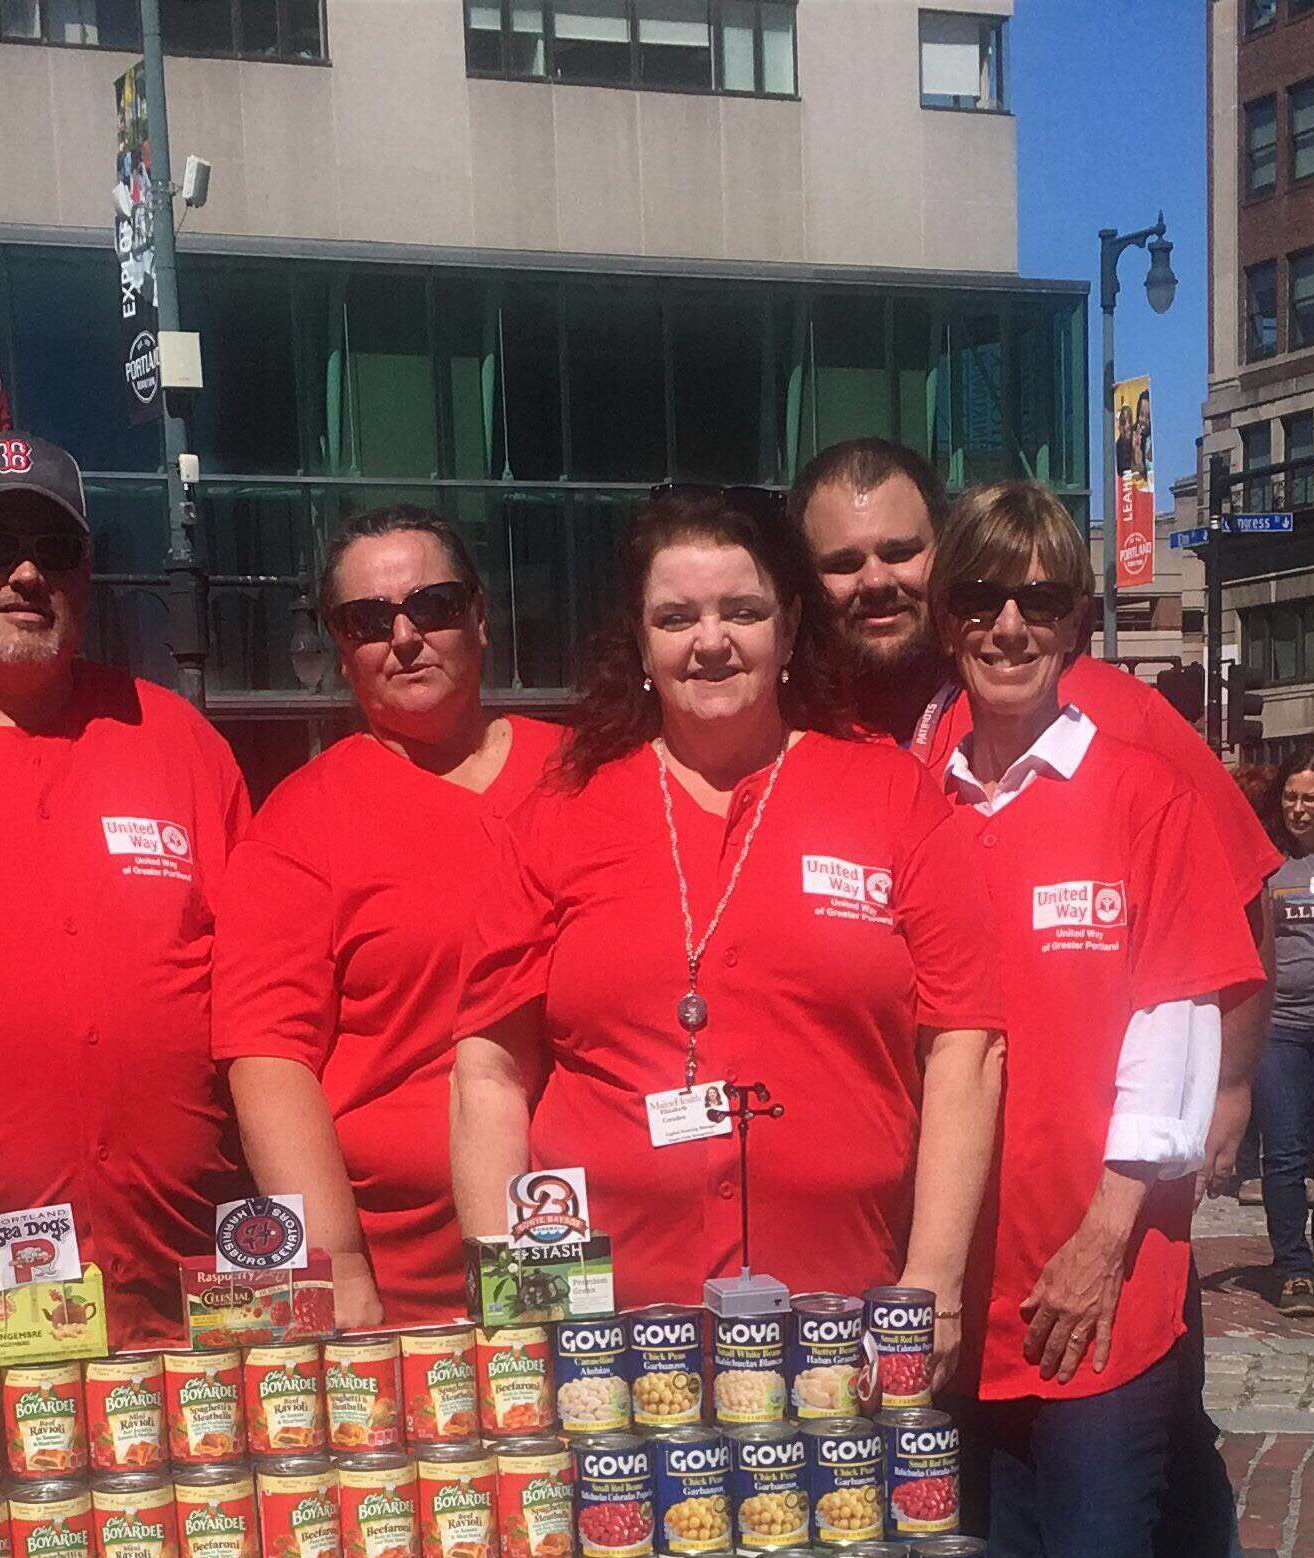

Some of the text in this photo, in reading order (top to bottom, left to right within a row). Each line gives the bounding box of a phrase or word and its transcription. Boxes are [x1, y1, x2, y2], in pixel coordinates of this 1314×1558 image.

[106, 822, 155, 834] United
[130, 835, 157, 852] Way
[135, 856, 160, 866] United
[806, 860, 859, 881] United
[829, 878, 860, 896] Way
[1037, 887, 1088, 906] United
[1056, 903, 1088, 922] Way
[1055, 930, 1103, 940] United Way
[24, 1218, 70, 1241] Dogs
[222, 1209, 267, 1266] HARRISBURG
[531, 1245, 582, 1260] STASH
[873, 1307, 933, 1328] GOYA
[561, 1327, 624, 1352] GOYA
[633, 1322, 695, 1346] GOYA
[718, 1321, 781, 1346] GOYA
[802, 1319, 862, 1343] GOYA
[492, 1352, 512, 1363] Chef
[643, 1351, 665, 1362] Chick
[643, 1360, 688, 1371] Garbanzos
[488, 1358, 546, 1375] BOYARDEE
[15, 1399, 77, 1418] BOYARDEE
[189, 1404, 224, 1414] Spaghetti
[192, 1411, 232, 1420] Meatballs
[29, 1426, 65, 1436] Ravioli
[822, 1435, 881, 1461] GOYA
[900, 1429, 959, 1453] GOYA
[670, 1446, 730, 1471] GOYA
[742, 1440, 804, 1465] GOYA
[584, 1453, 647, 1476] GOYA
[753, 1472, 773, 1482] Chick
[753, 1480, 798, 1492] Garbanzos
[433, 1492, 491, 1511] BOYARDEE
[105, 1518, 126, 1529] Chef
[102, 1524, 164, 1542] BOYARDEE
